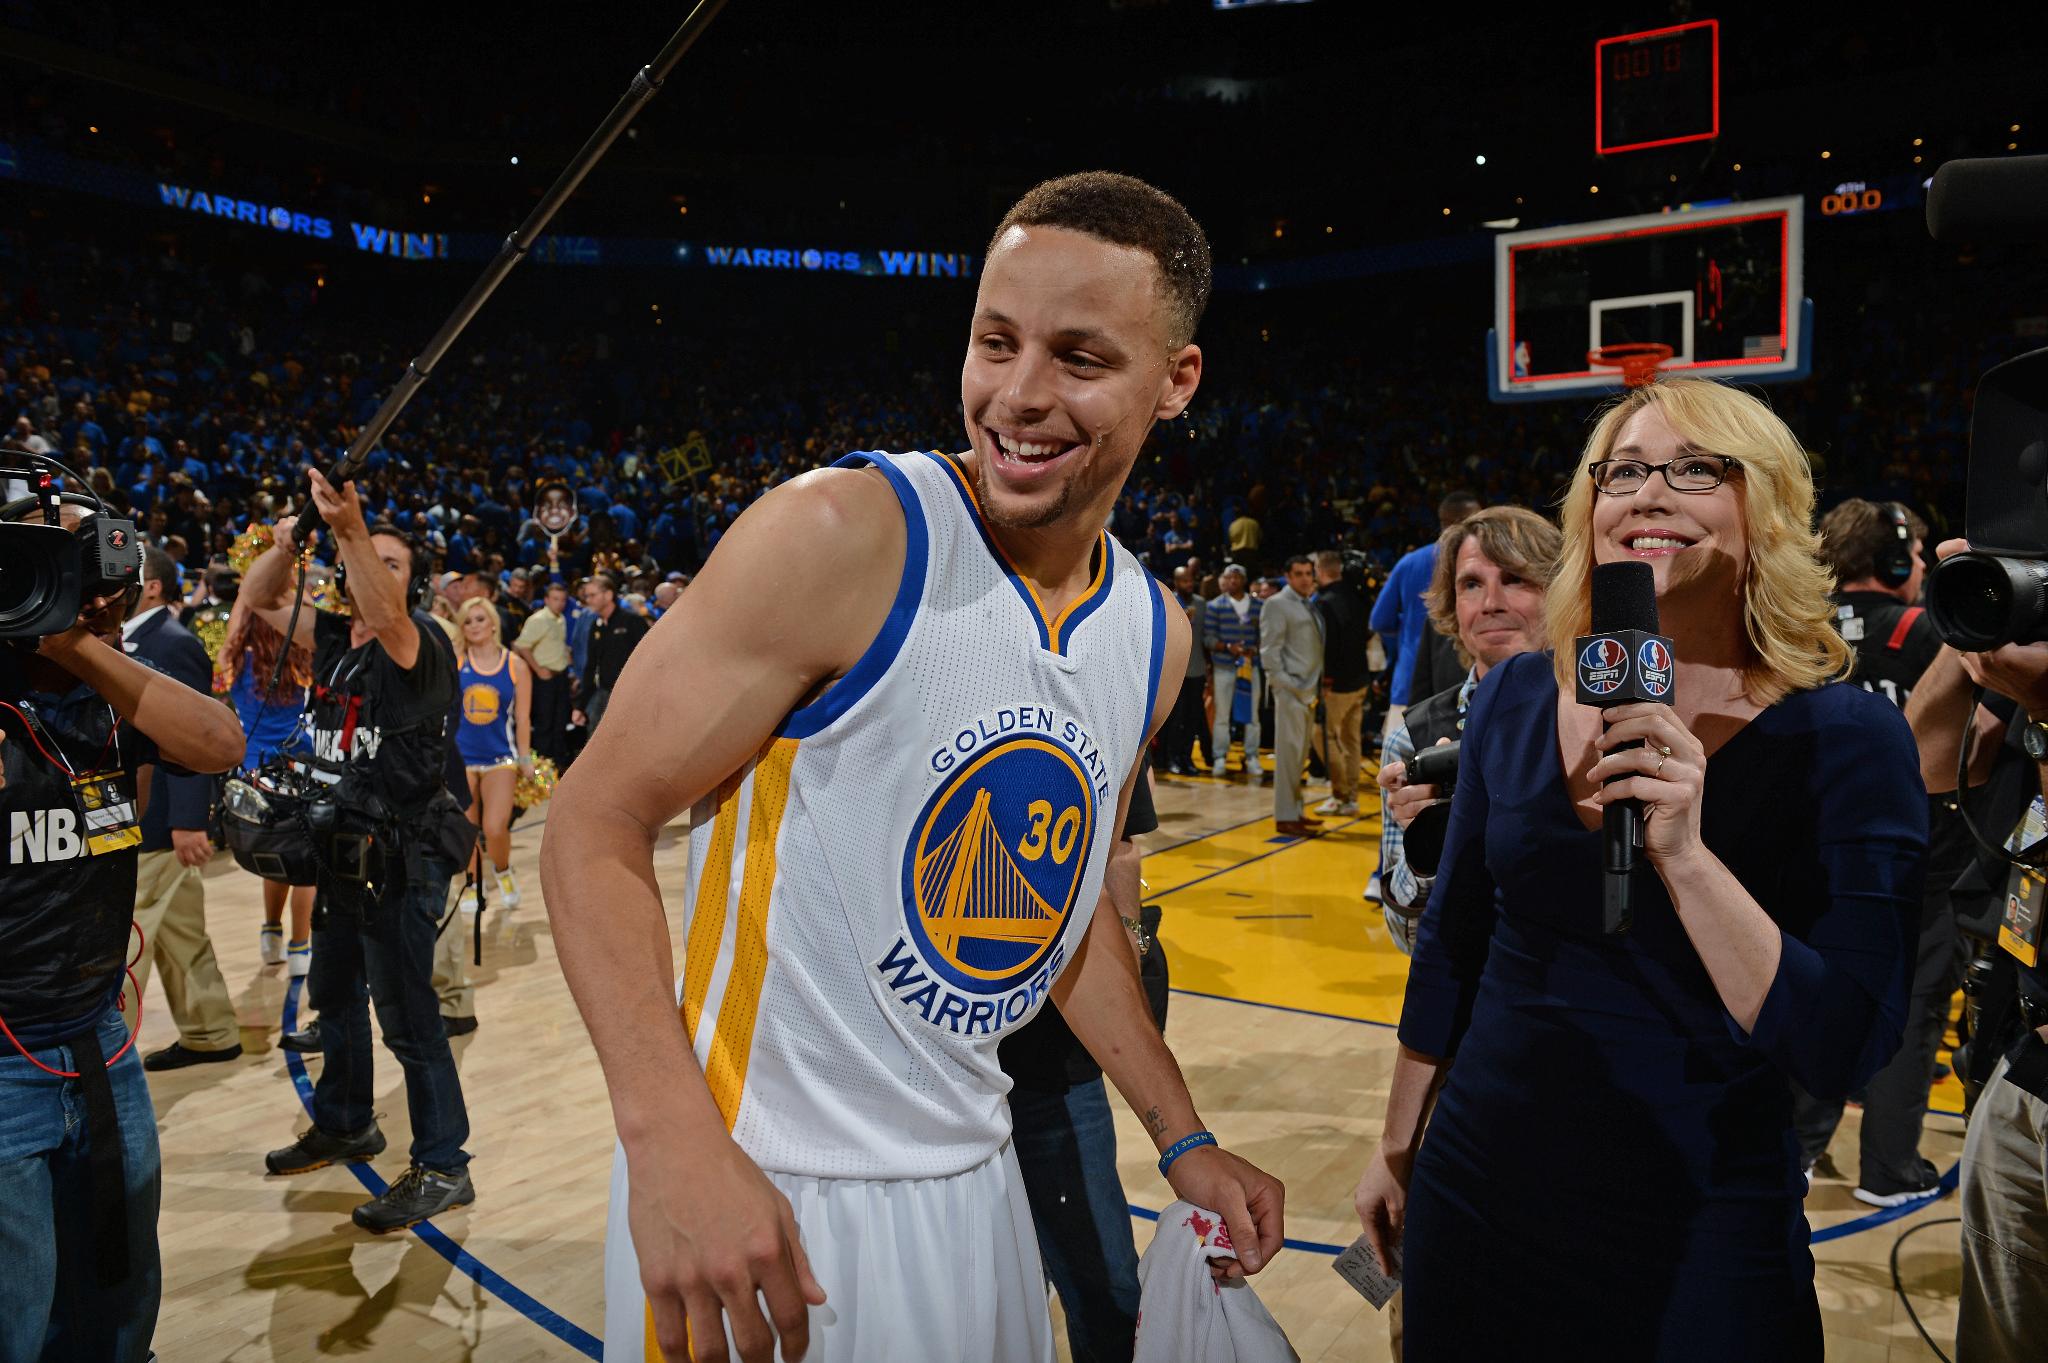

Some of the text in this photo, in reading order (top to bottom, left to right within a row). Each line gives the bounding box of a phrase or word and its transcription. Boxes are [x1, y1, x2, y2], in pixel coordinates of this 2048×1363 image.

[159, 183, 448, 259] WARRIORS WIN!
[705, 247, 861, 271] WARRIORS
[1589, 669, 1619, 681] ESPN
[1645, 669, 1666, 683] ESPN
[931, 706, 1109, 806] GOLDEN STATE
[1018, 799, 1081, 865] 30
[877, 936, 1064, 1035] WARRIORS
[1181, 1134, 1208, 1147] NAME
